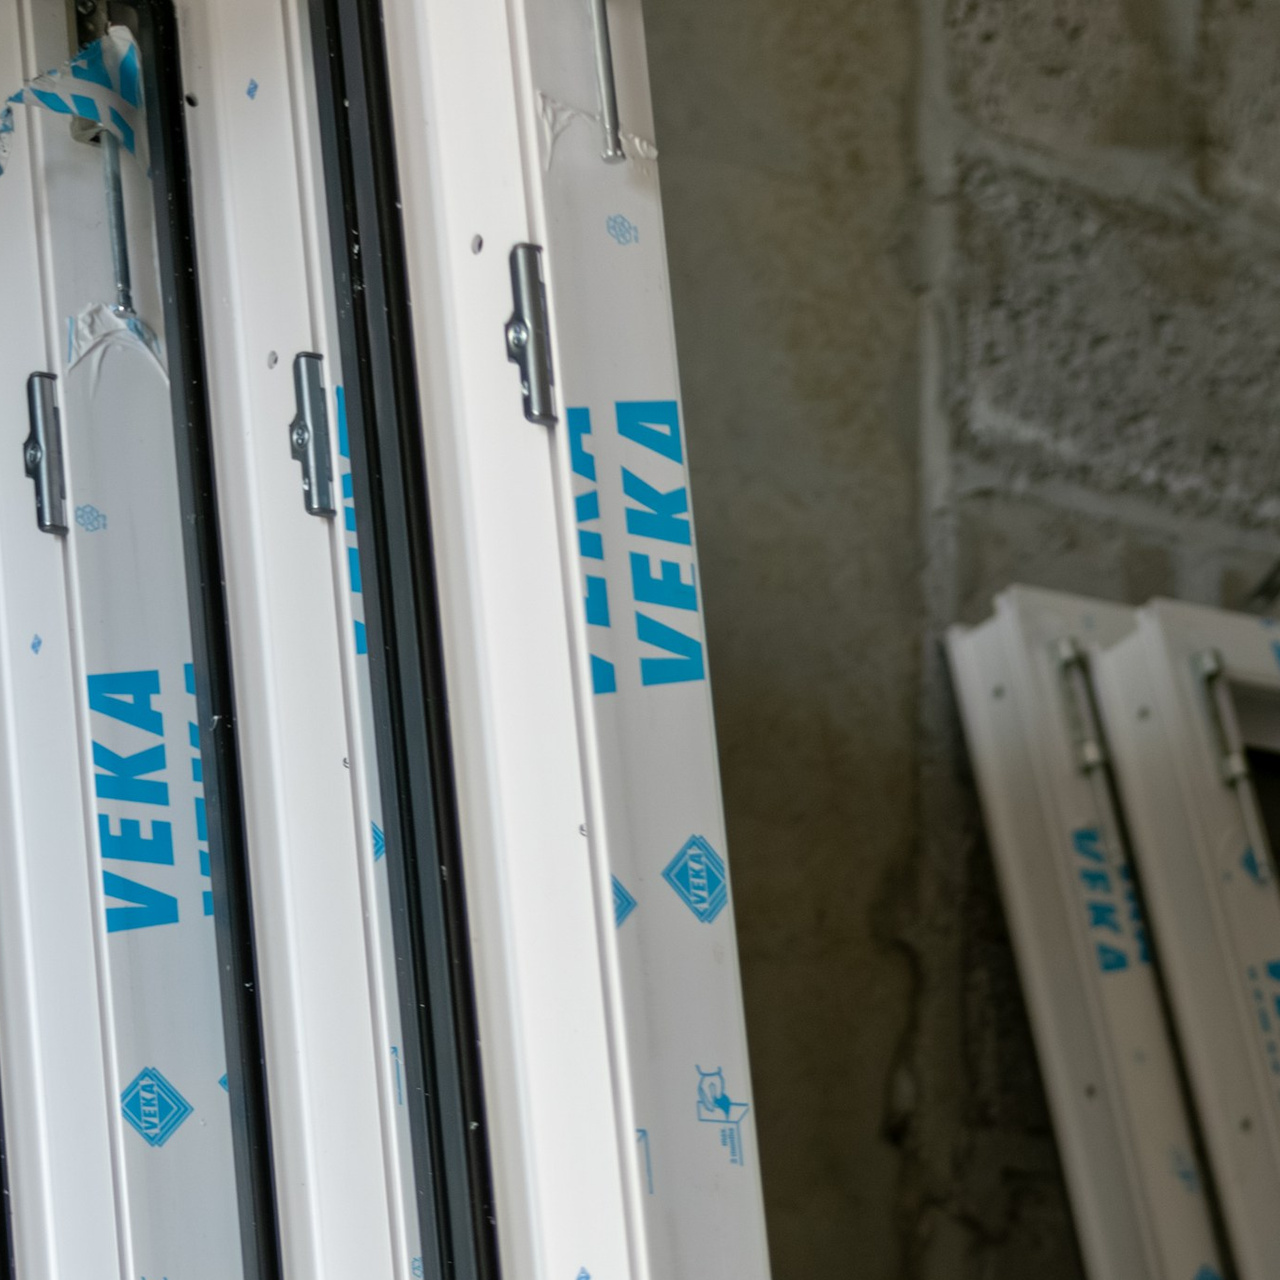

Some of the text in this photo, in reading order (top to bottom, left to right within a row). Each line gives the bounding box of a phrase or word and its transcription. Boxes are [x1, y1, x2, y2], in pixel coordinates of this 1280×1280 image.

[614, 399, 706, 688] VEKA
[85, 668, 181, 935] VEKA
[688, 853, 708, 905] VEKA
[1072, 828, 1129, 973] VEKA
[140, 1083, 159, 1131] VEKA
